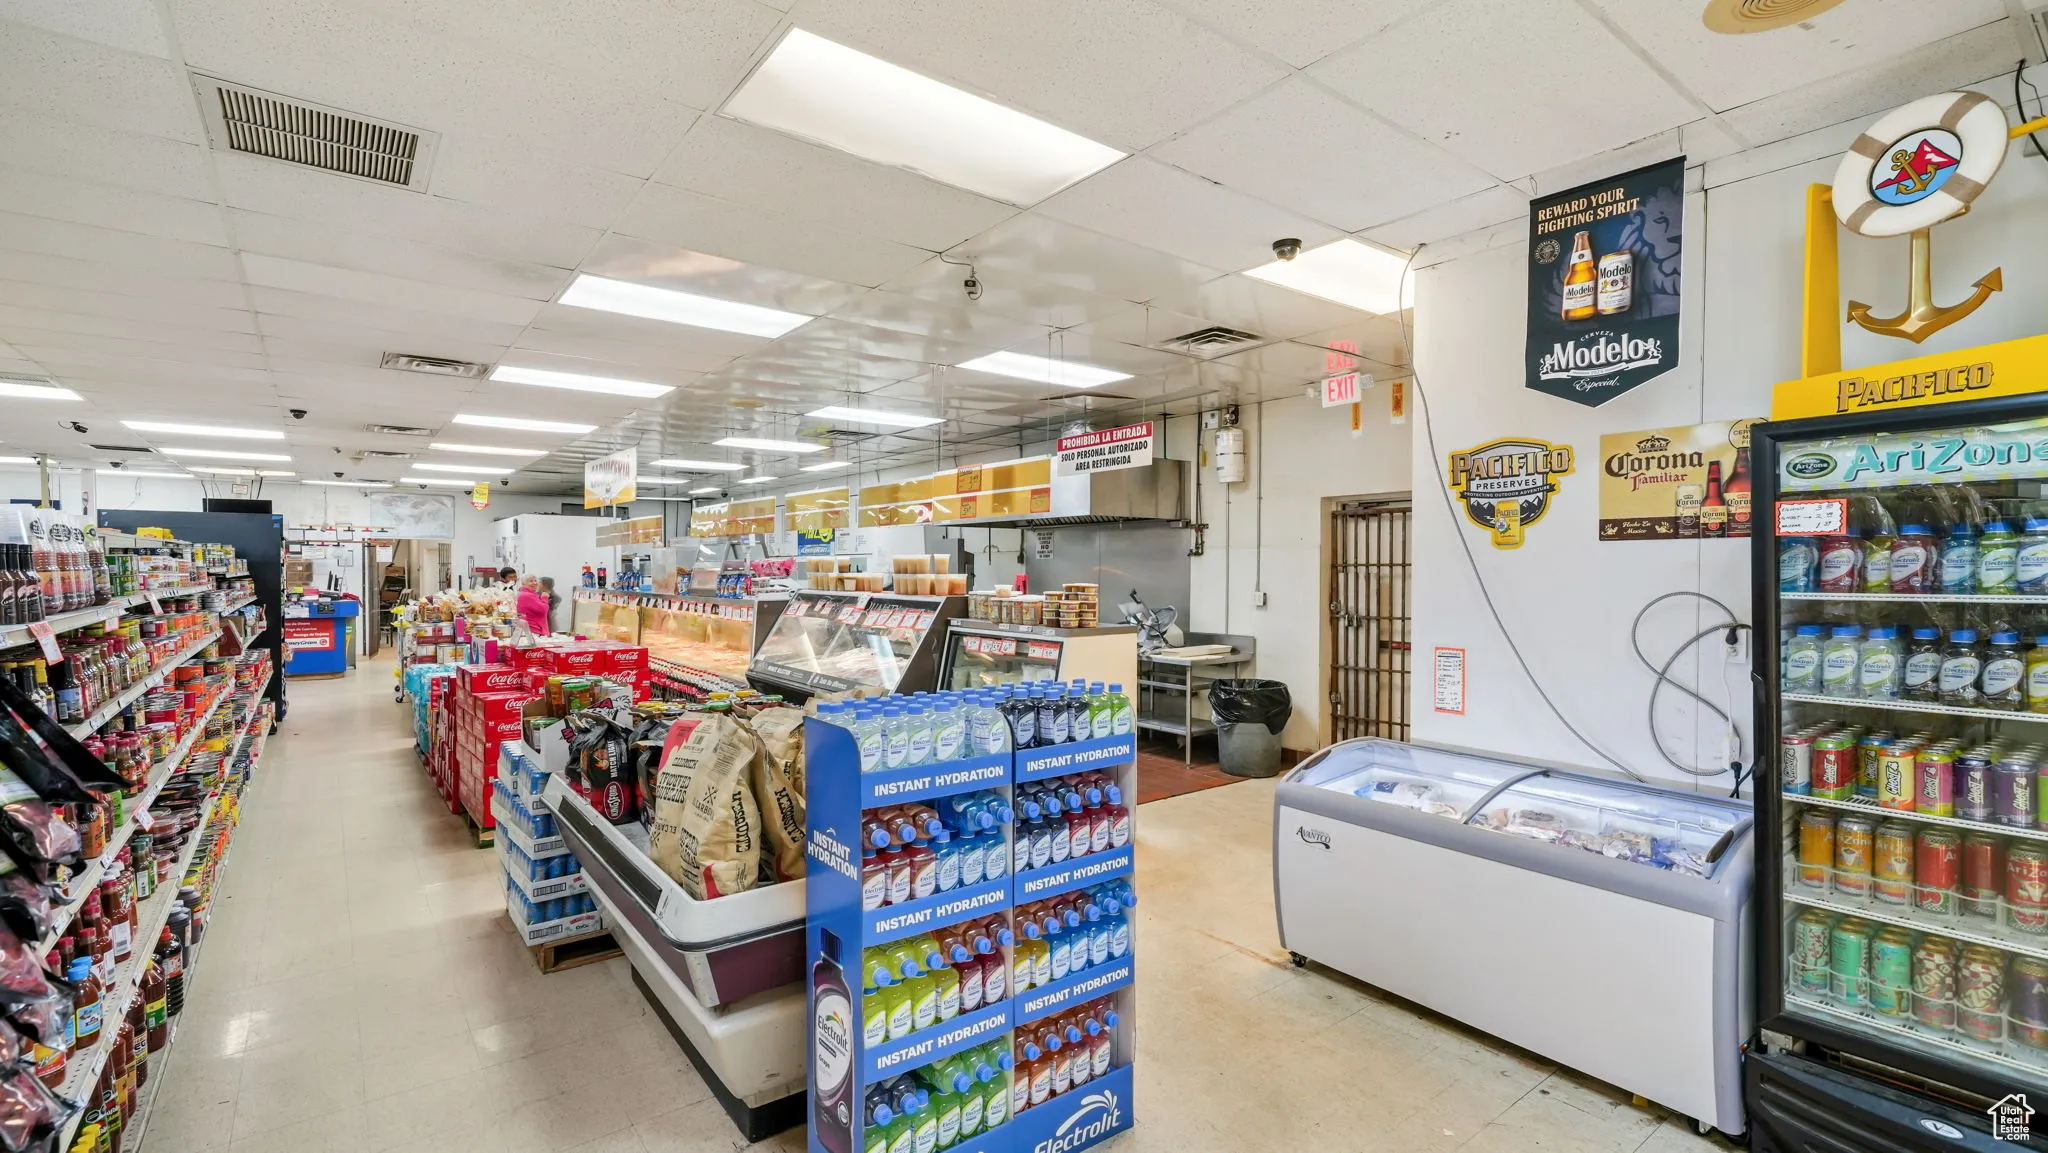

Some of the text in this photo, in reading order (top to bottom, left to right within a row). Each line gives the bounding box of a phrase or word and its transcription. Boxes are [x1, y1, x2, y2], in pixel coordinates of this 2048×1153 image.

[1537, 198, 1640, 235] FIGHTING SPIRIT
[1538, 187, 1625, 221] REWARD YOUR
[1600, 263, 1632, 280] Modelo
[1568, 285, 1594, 296] Modelo
[1580, 330, 1614, 342] CERVEZA
[1552, 332, 1645, 371] Modelo
[1327, 375, 1356, 402] EXIT
[1837, 361, 1994, 413] PACIFICO
[1061, 440, 1148, 462] SOLO PERSONAL AUTORIZADO
[1062, 425, 1147, 449] PROHIBIDA LA ENTRADA
[1075, 454, 1131, 471] AREA RESTRINGIDA
[1451, 448, 1571, 486] PACIFICO
[1605, 451, 1704, 479] Corona
[1464, 491, 1494, 499] PROTECTING
[1520, 485, 1550, 496] ADVENTURE
[1476, 478, 1537, 491] PRESERVES
[1630, 472, 1688, 492] Familiar
[568, 653, 594, 663] Coca-Cola
[614, 651, 638, 661] Coca-Cola
[609, 757, 618, 778] MATCH
[1026, 744, 1130, 772] INSTANT HYDRATION
[874, 765, 1004, 797] INSTANT HYDRATION
[607, 784, 620, 817] KINGSFORD
[813, 829, 850, 861] INSTANT
[1296, 826, 1331, 847] AVANTCO
[808, 841, 858, 881] HYDRATION
[1024, 855, 1129, 893] INSTANT HYDRATION
[876, 889, 1004, 933] INSTANT HYDRATION
[1024, 967, 1129, 1013] INSTANT HYDRATION
[818, 1015, 848, 1052] Electrolit
[877, 1039, 934, 1069] INSTANT
[937, 1013, 1006, 1048] HYDRATION
[1034, 1108, 1121, 1153] Electrolit
